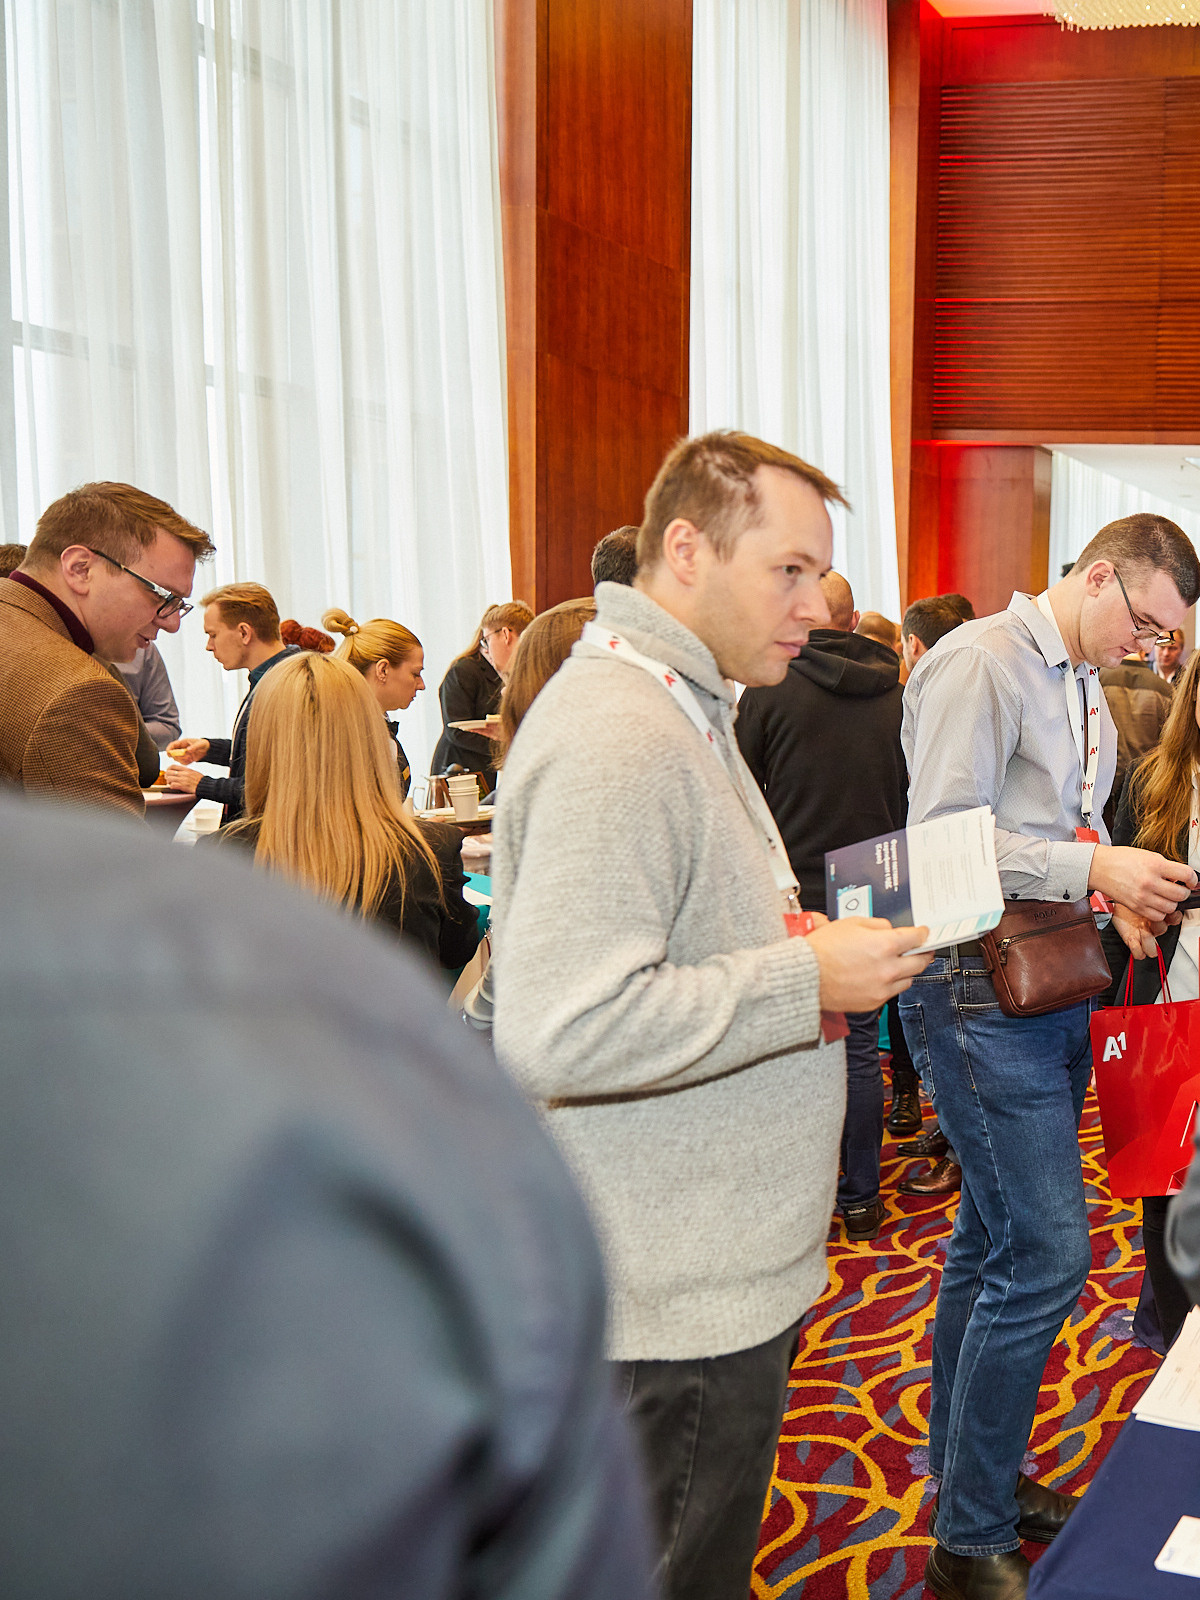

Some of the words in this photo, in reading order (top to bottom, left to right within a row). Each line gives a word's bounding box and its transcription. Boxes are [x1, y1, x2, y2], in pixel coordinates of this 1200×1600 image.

[1089, 707, 1099, 716] A1
[1089, 746, 1098, 756] A1
[1191, 817, 1199, 828] A1
[1102, 1031, 1127, 1062] A1
